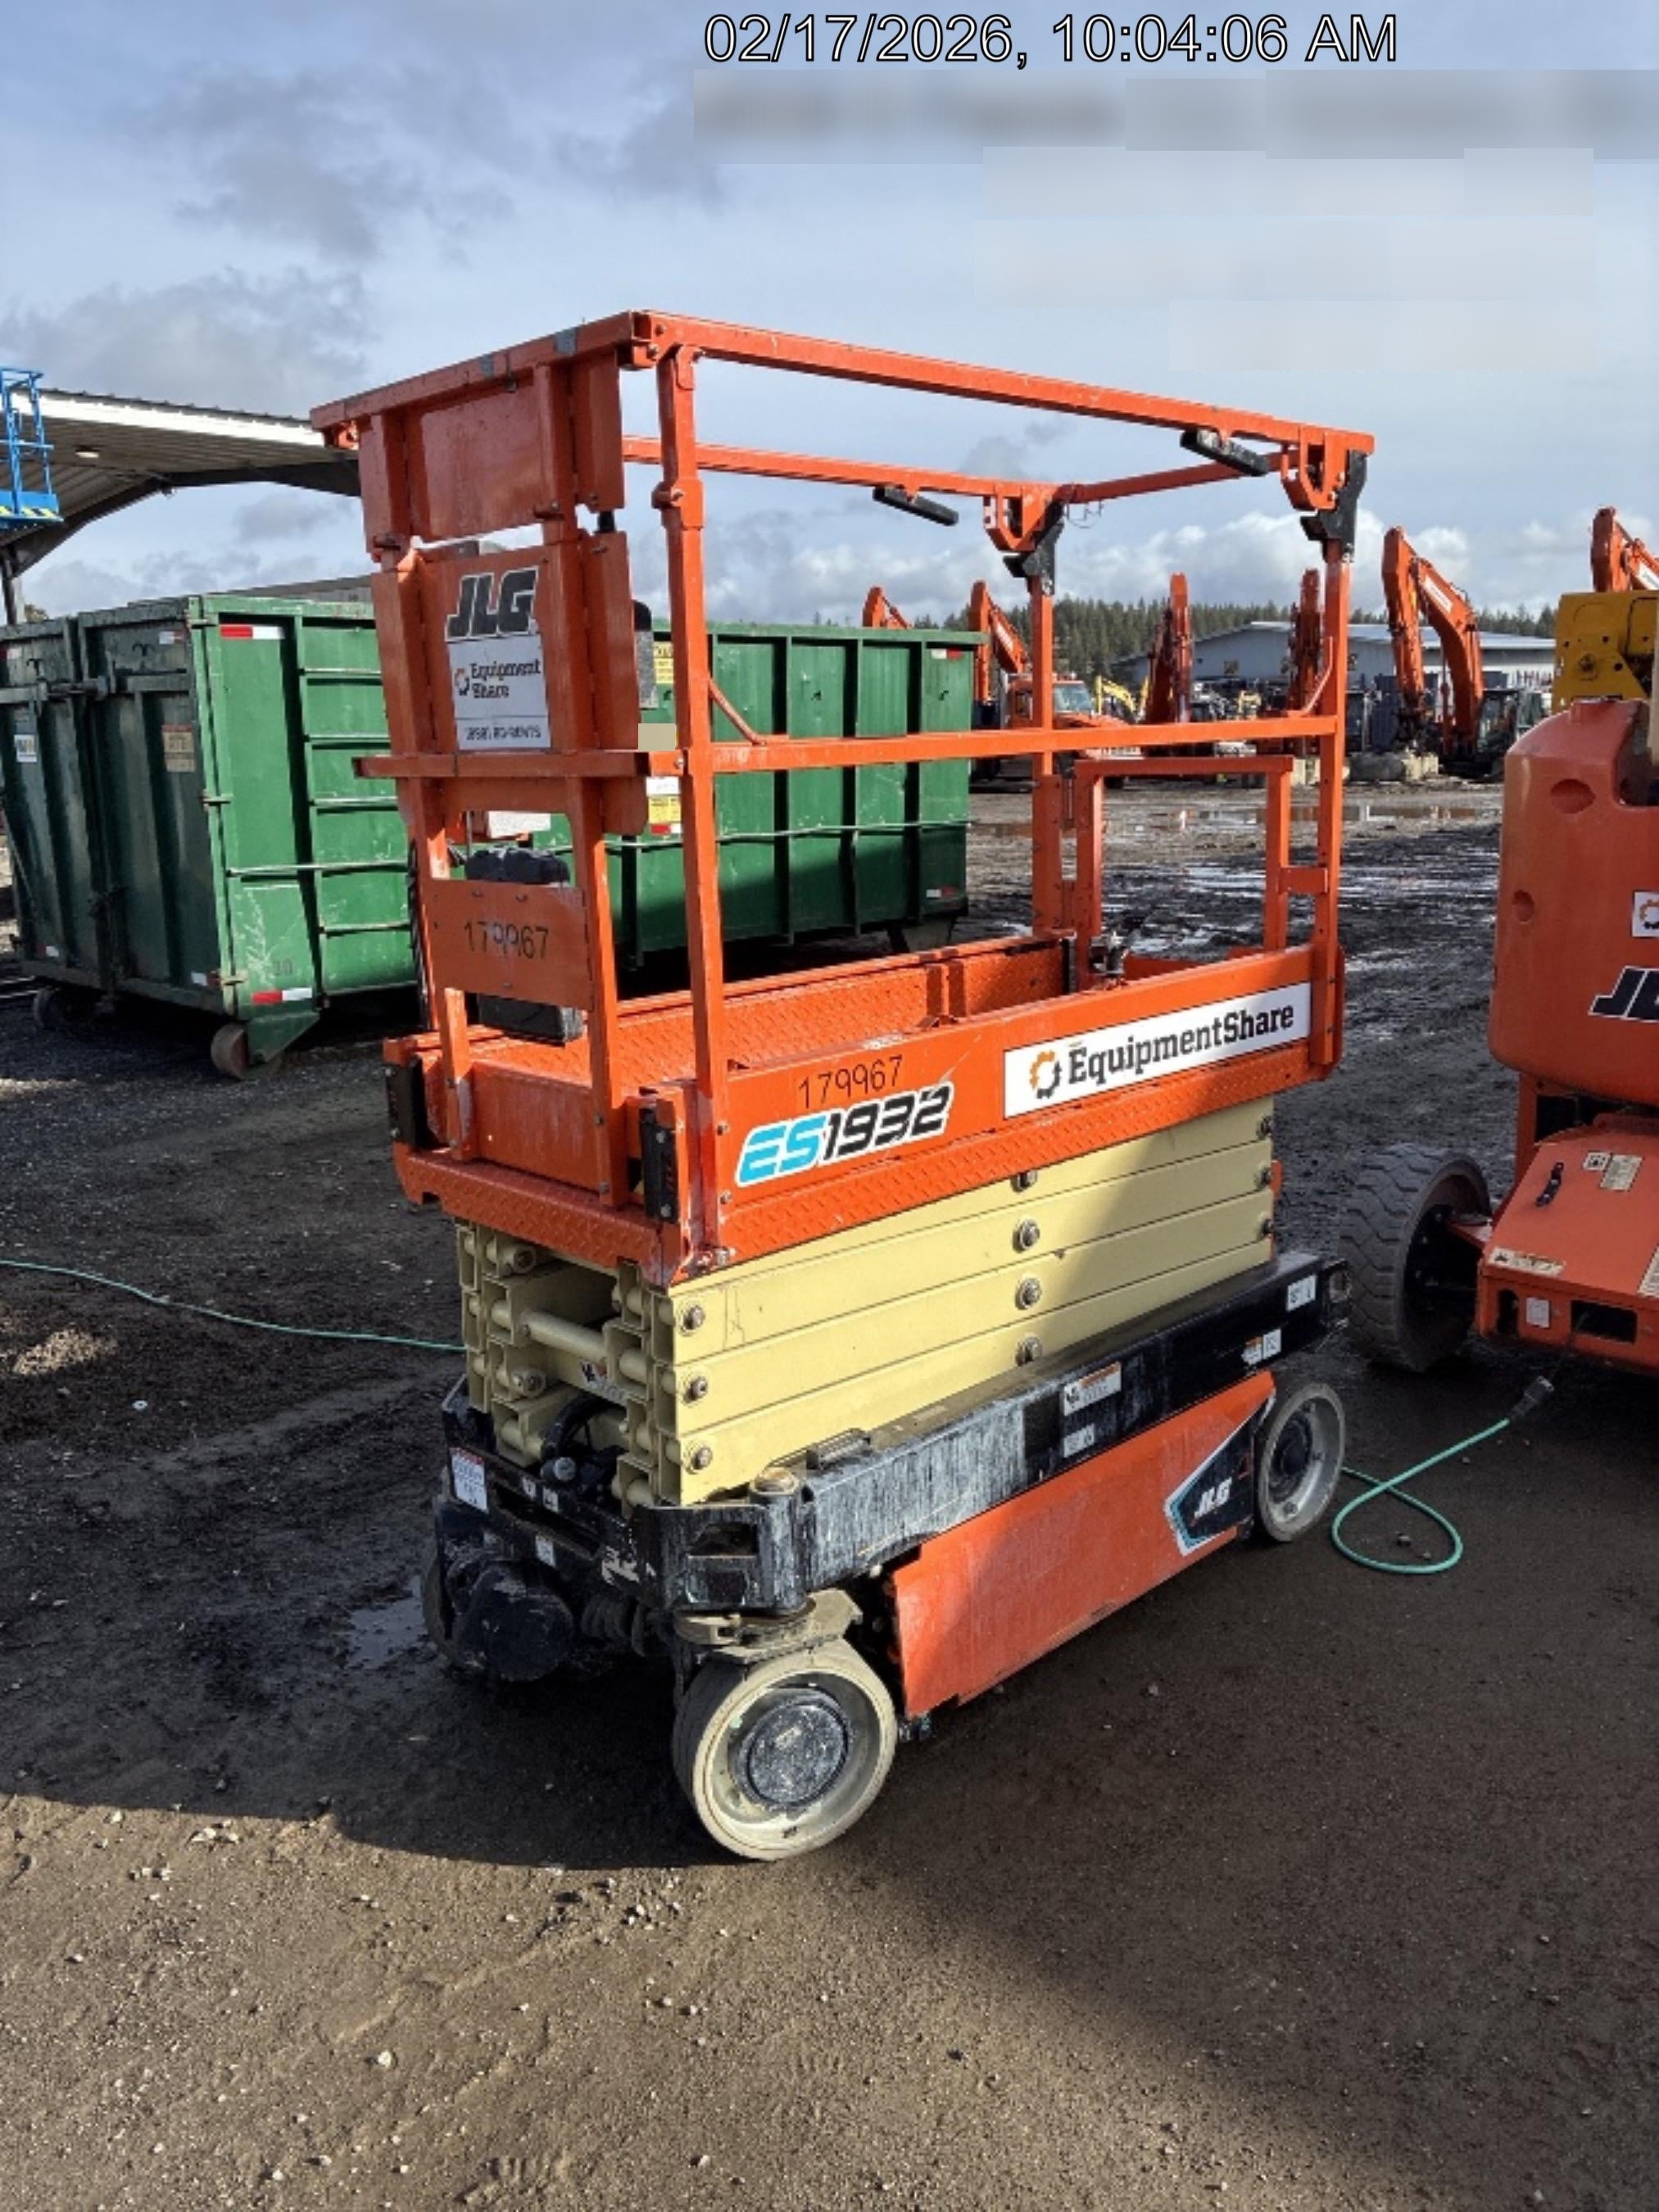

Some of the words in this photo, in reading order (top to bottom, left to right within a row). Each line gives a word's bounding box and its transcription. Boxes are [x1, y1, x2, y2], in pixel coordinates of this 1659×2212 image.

[445, 565, 539, 641] JLG
[469, 658, 542, 682] Equipment
[464, 919, 550, 959] 179967
[1067, 1004, 1294, 1085] EquipmentShare
[798, 1054, 903, 1108] 179967
[736, 1081, 954, 1187] ES1932
[1194, 1476, 1233, 1520] JLG
